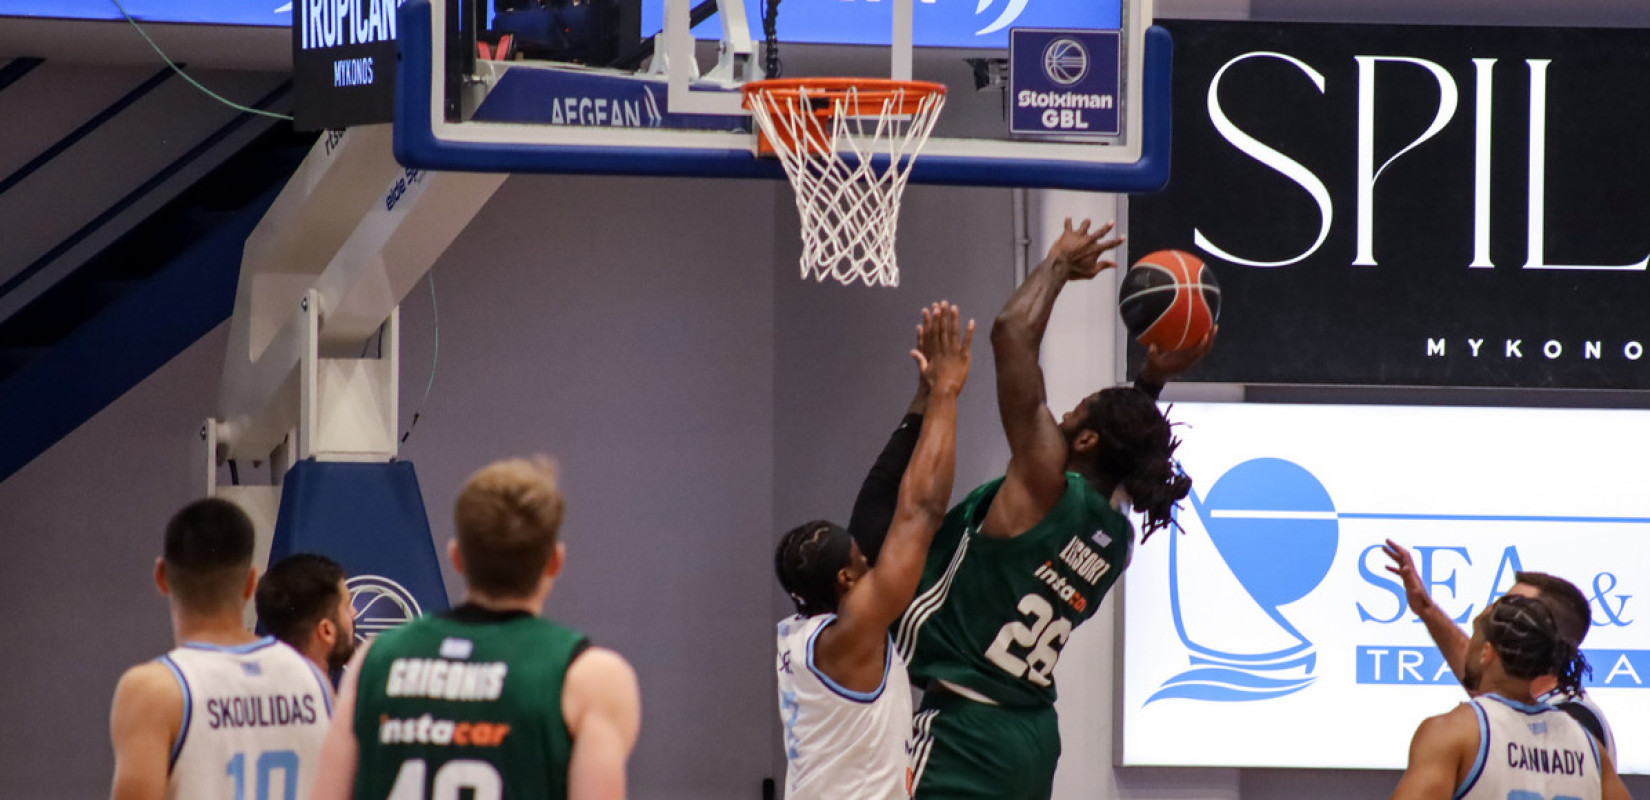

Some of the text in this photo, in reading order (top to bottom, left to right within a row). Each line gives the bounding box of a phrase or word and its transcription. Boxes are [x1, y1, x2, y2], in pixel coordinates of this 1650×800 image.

[302, 0, 403, 50] TROPICAN
[334, 57, 374, 87] MYKONOS
[1017, 90, 1113, 109] Stoiximan
[1042, 109, 1089, 129] GBL
[1194, 51, 1650, 270] SPIL
[1427, 338, 1643, 361] MYKONO
[1588, 571, 1634, 627] &
[984, 593, 1073, 688] 26
[207, 694, 316, 729] SKOULIDAS
[1507, 742, 1584, 777] CANNADY
